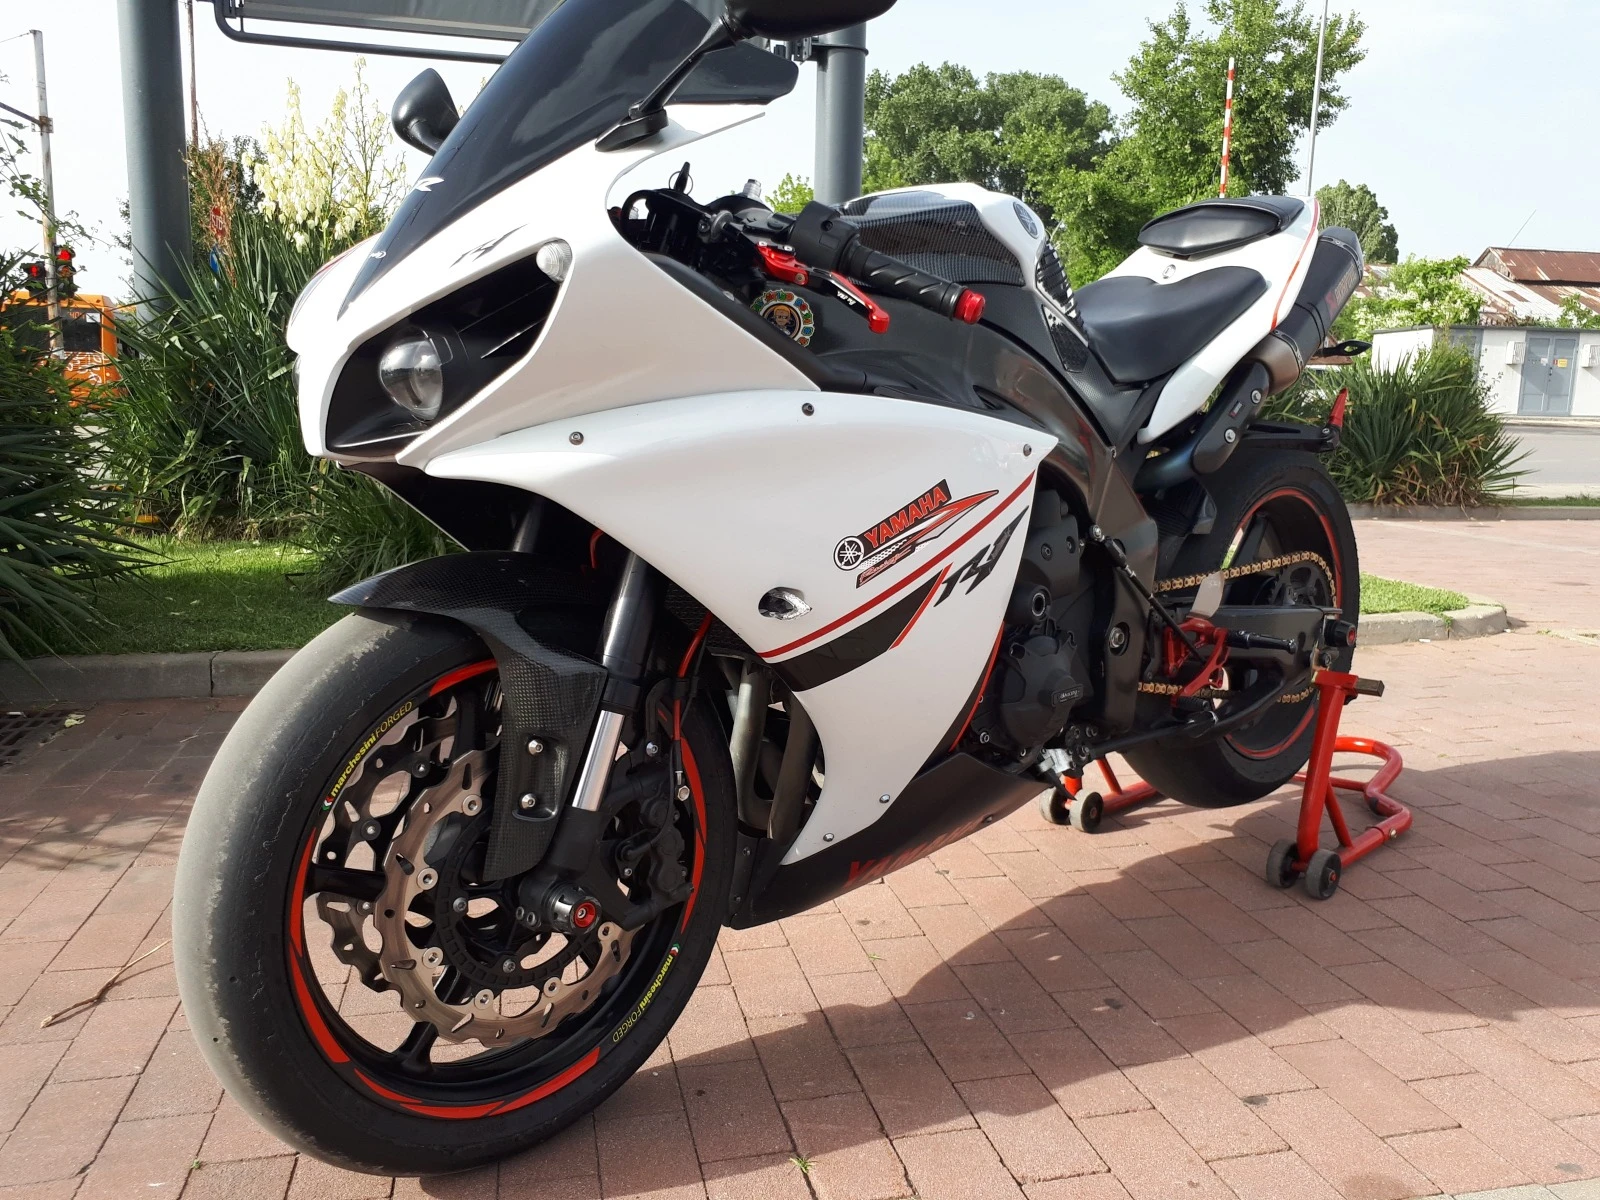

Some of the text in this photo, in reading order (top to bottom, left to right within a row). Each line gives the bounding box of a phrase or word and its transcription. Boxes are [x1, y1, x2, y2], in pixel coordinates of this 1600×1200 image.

[864, 486, 948, 549] YAMAHA
[330, 701, 413, 798] marchesini FORGED
[612, 954, 674, 1043] marchesini FORGED
